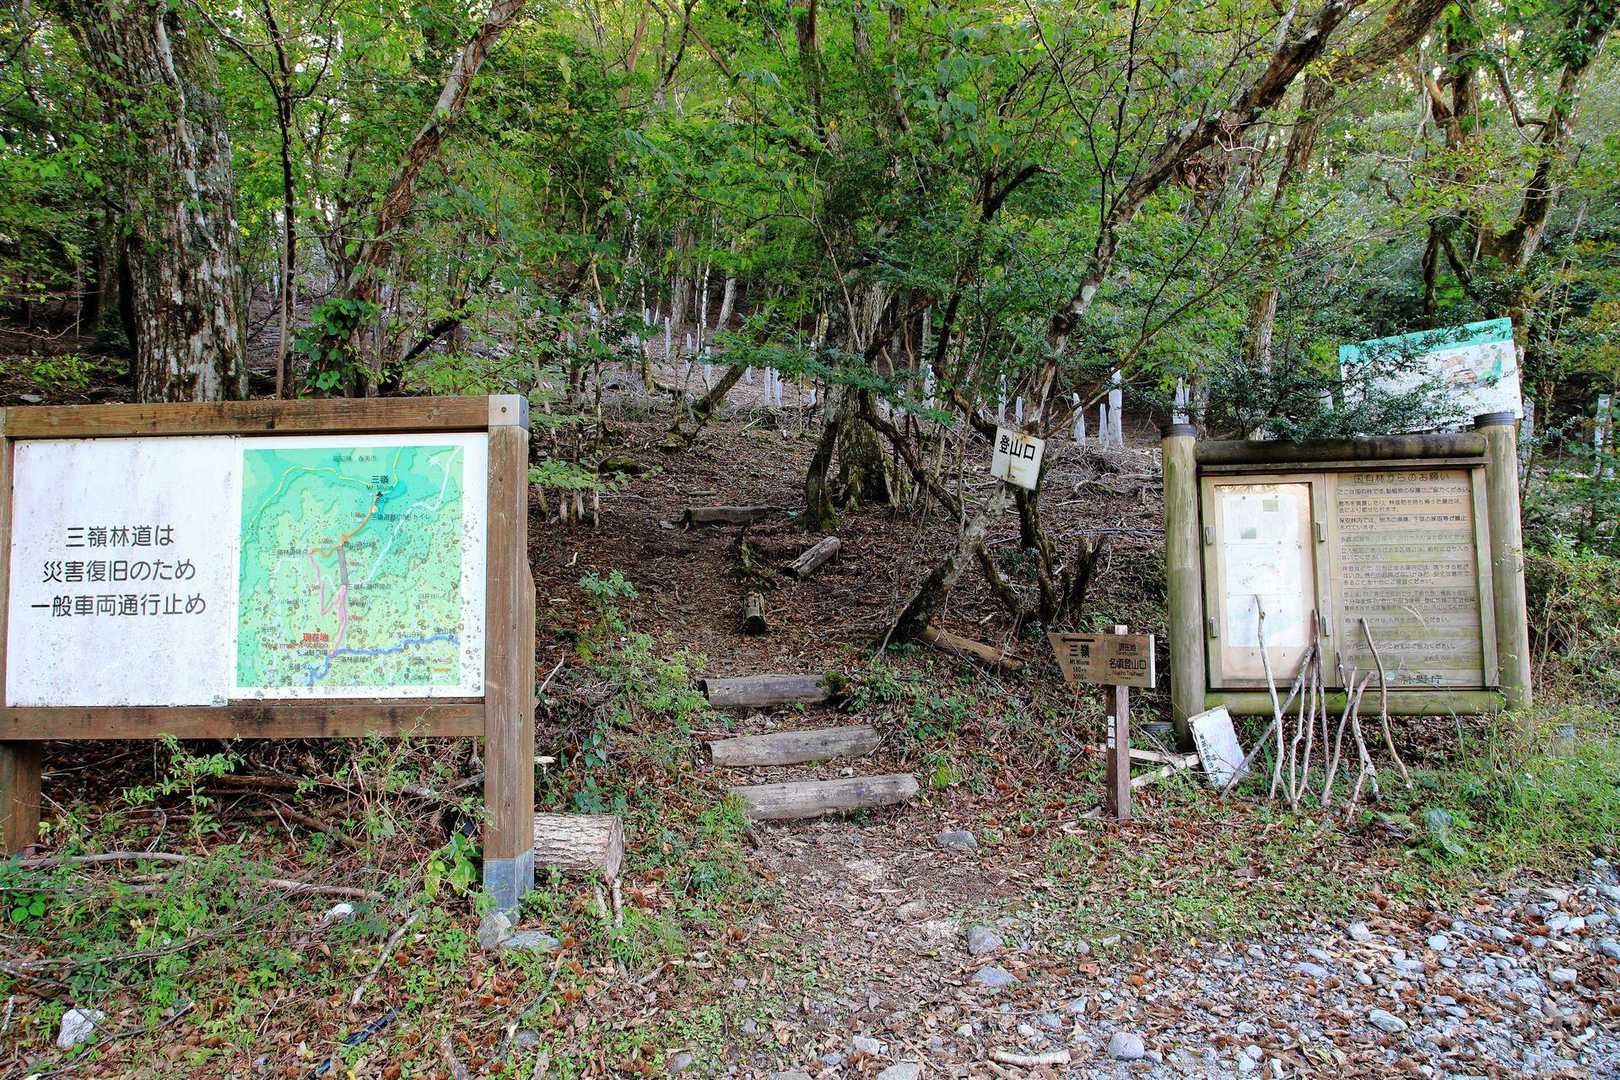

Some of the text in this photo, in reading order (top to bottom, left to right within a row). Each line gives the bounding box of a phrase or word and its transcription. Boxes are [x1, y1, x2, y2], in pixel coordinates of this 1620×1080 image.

[999, 434, 1036, 461] 登山口
[65, 524, 175, 548] 三嶺林道は
[42, 558, 196, 583] 災害復旧のため
[31, 593, 207, 617] 一般車両通行止め
